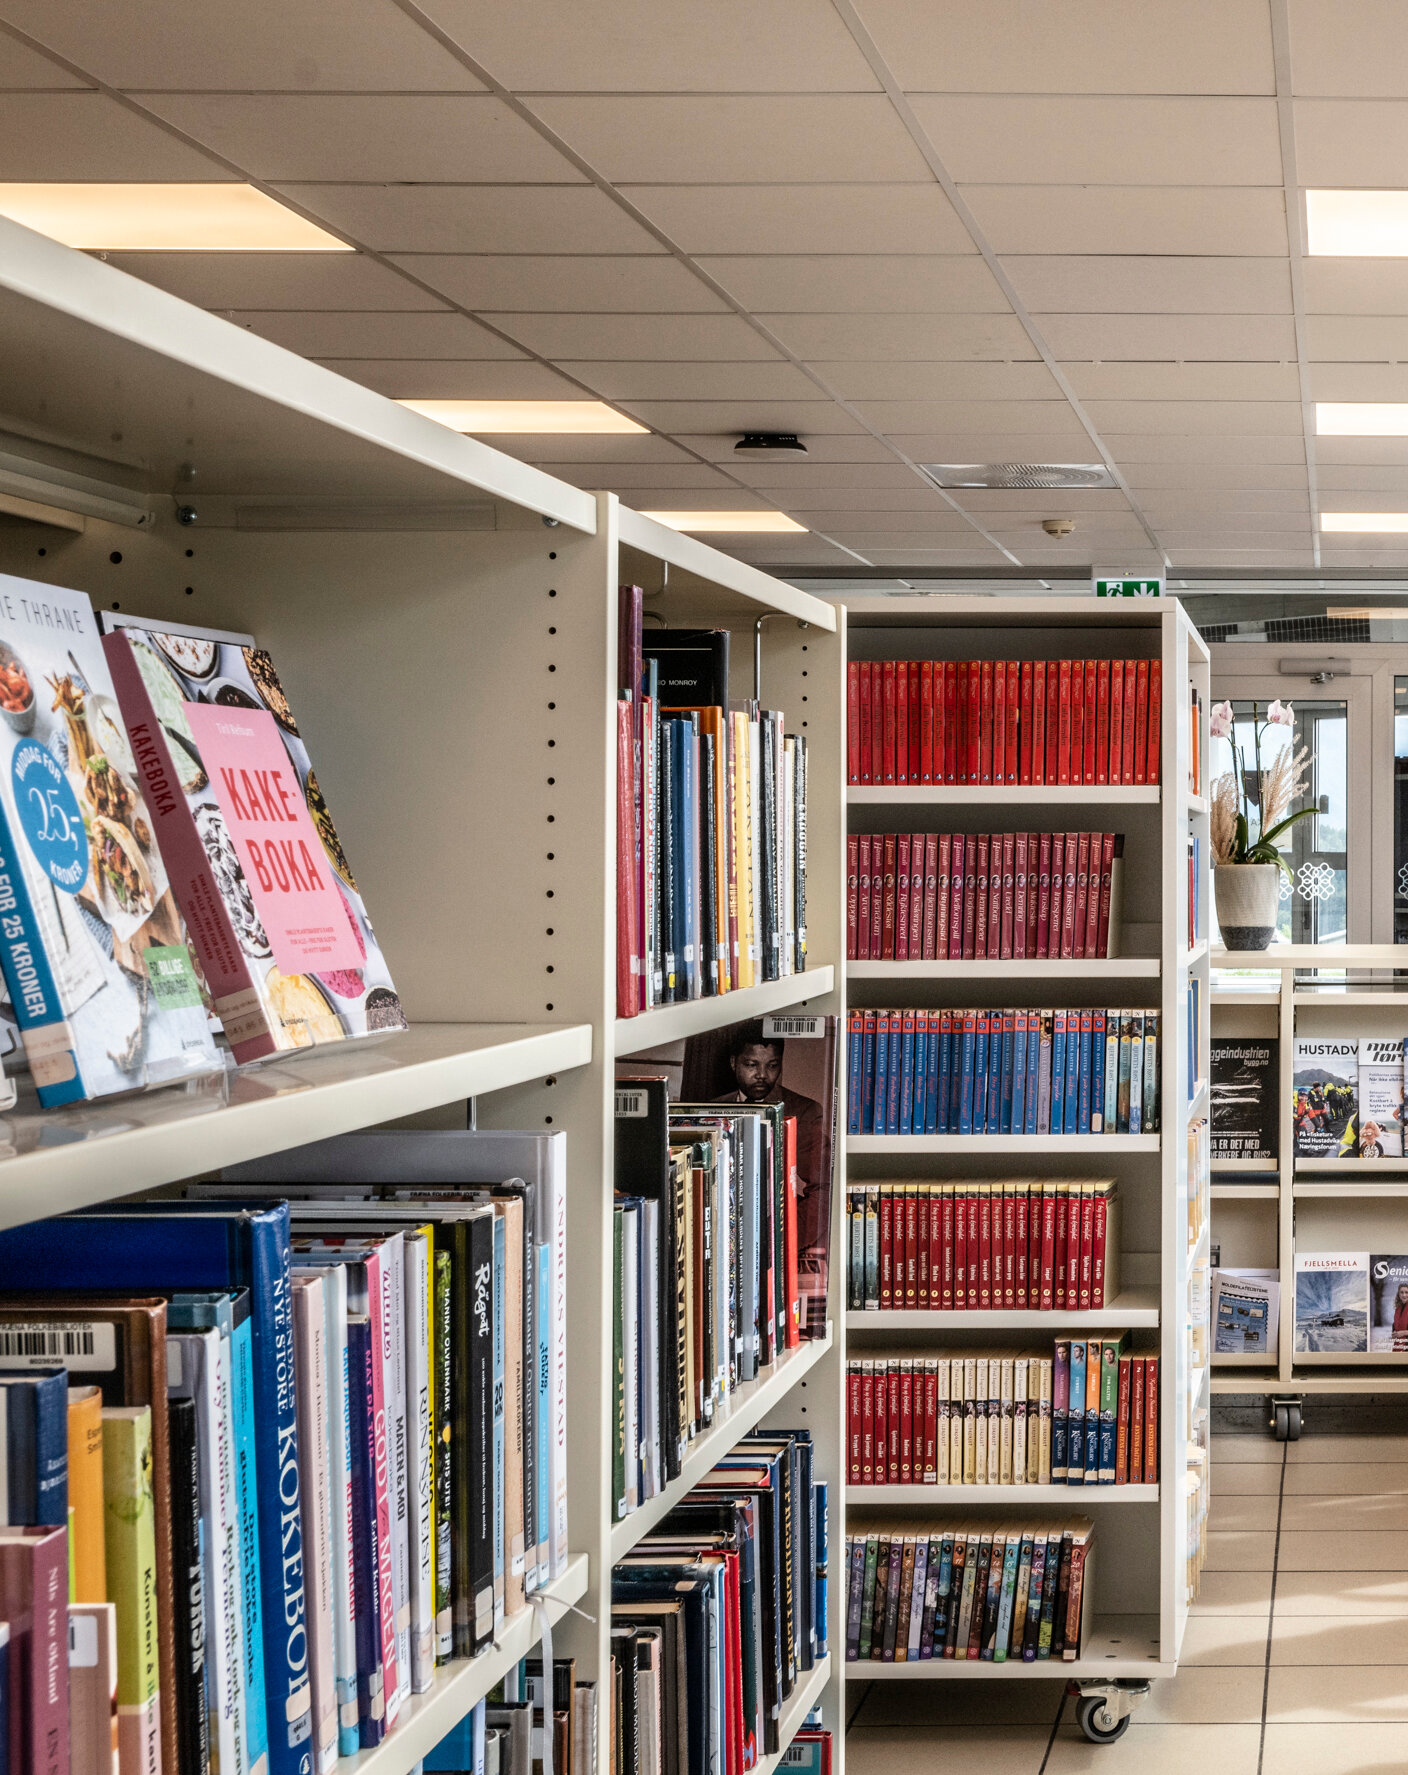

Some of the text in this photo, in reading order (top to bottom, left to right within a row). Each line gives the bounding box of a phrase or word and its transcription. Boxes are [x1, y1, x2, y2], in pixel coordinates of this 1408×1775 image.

[21, 600, 84, 634] THRANE
[15, 746, 62, 784] MIDDAG FOR
[129, 723, 177, 817] KAKEBOKA
[220, 767, 298, 822] KAKE-
[50, 860, 84, 885] KRONER
[245, 838, 325, 893] BOKA
[952, 892, 960, 939] Mellomspill
[1015, 891, 1025, 922] Demring
[2, 915, 48, 1018] 25 KRONER
[1219, 1140, 1260, 1149] ER DET MED
[1300, 1143, 1337, 1151] Næringsforum
[283, 1247, 295, 1409] GYLDENDALS
[525, 1283, 533, 1356] Stuhaug
[273, 1278, 288, 1416] NYE STORE
[419, 1386, 428, 1449] REN
[374, 1409, 388, 1507] GODT
[396, 1415, 405, 1521] MATEN & MOI
[1071, 1430, 1080, 1461] KINGSBURY
[1087, 1431, 1095, 1462] KINGSBURY
[1101, 1432, 1110, 1462] KINGSBURY
[48, 1566, 58, 1601] Nils
[240, 1449, 253, 1687] glutenfrie kokeboka
[48, 1608, 58, 1638] Are
[144, 1567, 152, 1655] Kunsten
[379, 1534, 395, 1671] MAGEN
[147, 1663, 154, 1675] å
